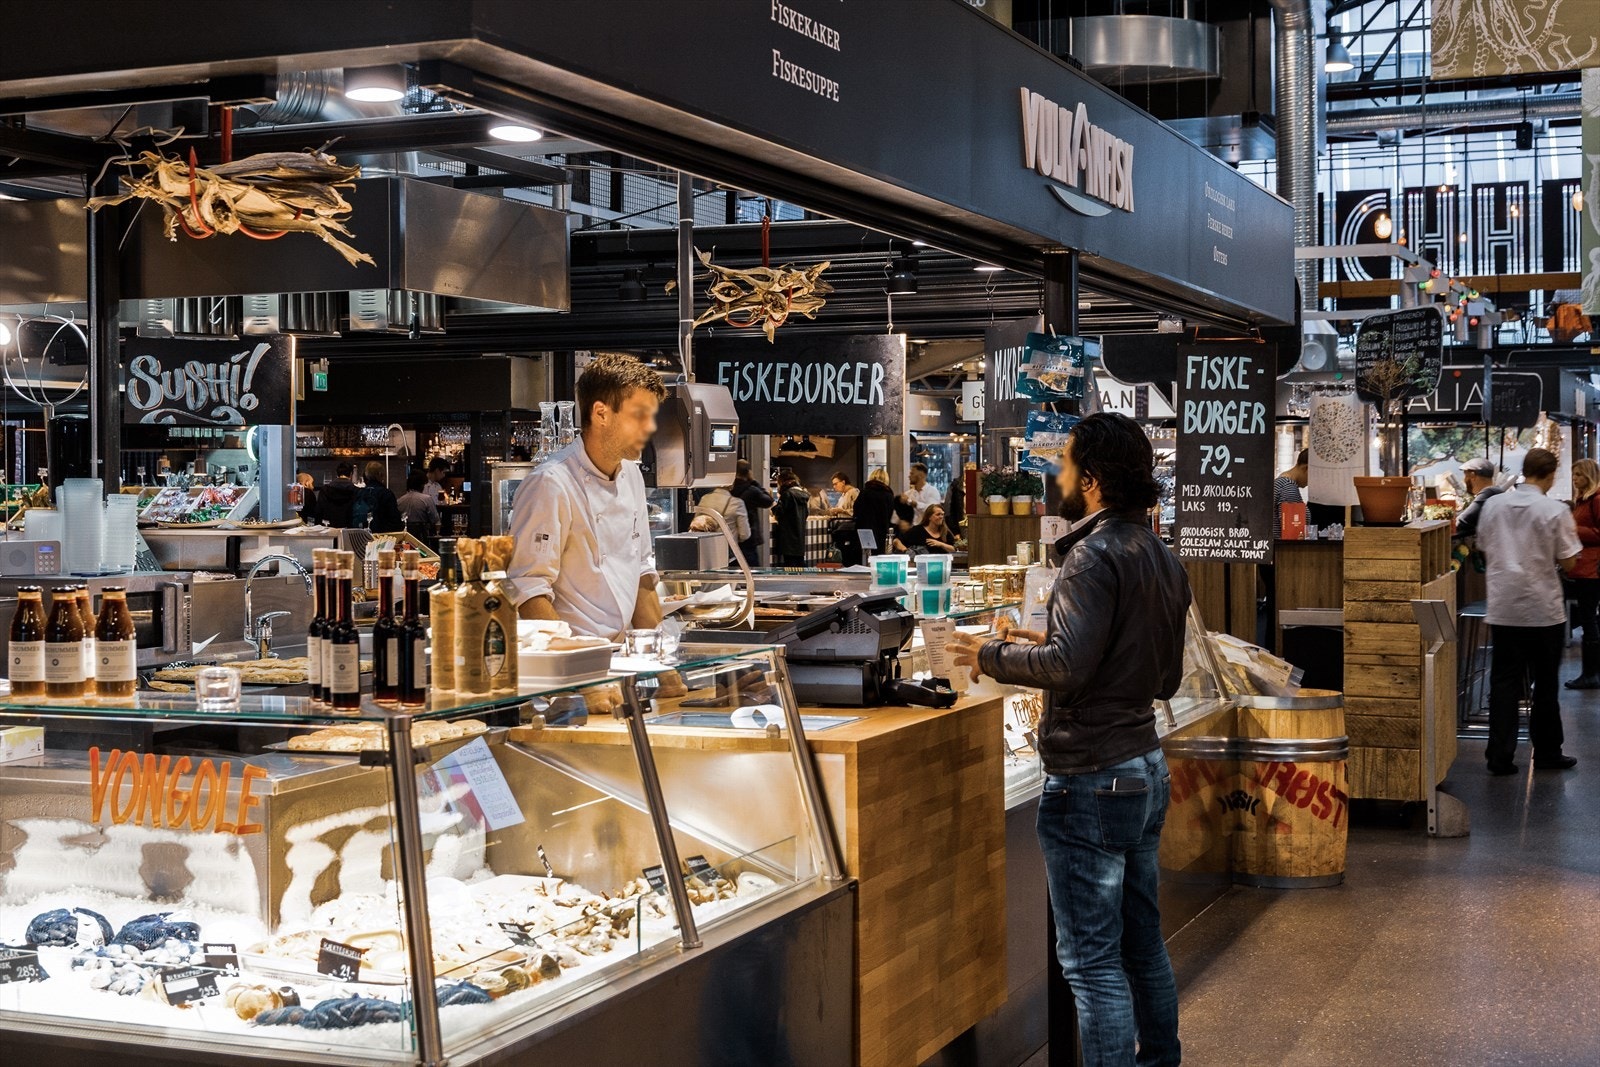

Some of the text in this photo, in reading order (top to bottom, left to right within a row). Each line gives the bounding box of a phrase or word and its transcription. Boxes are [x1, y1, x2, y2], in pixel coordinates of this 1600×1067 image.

[770, 0, 841, 51] FISKEKAKER
[772, 48, 840, 103] FISKESUPPE
[1020, 87, 1135, 213] VULKANFISK
[1183, 400, 1266, 435] BURGER
[1182, 484, 1200, 497] MED
[1182, 501, 1206, 512] LAKS
[1180, 548, 1209, 557] SYLTET
[1240, 550, 1266, 560] TOMAT
[1253, 540, 1270, 550] LØK
[88, 746, 268, 836] VONGOLE
